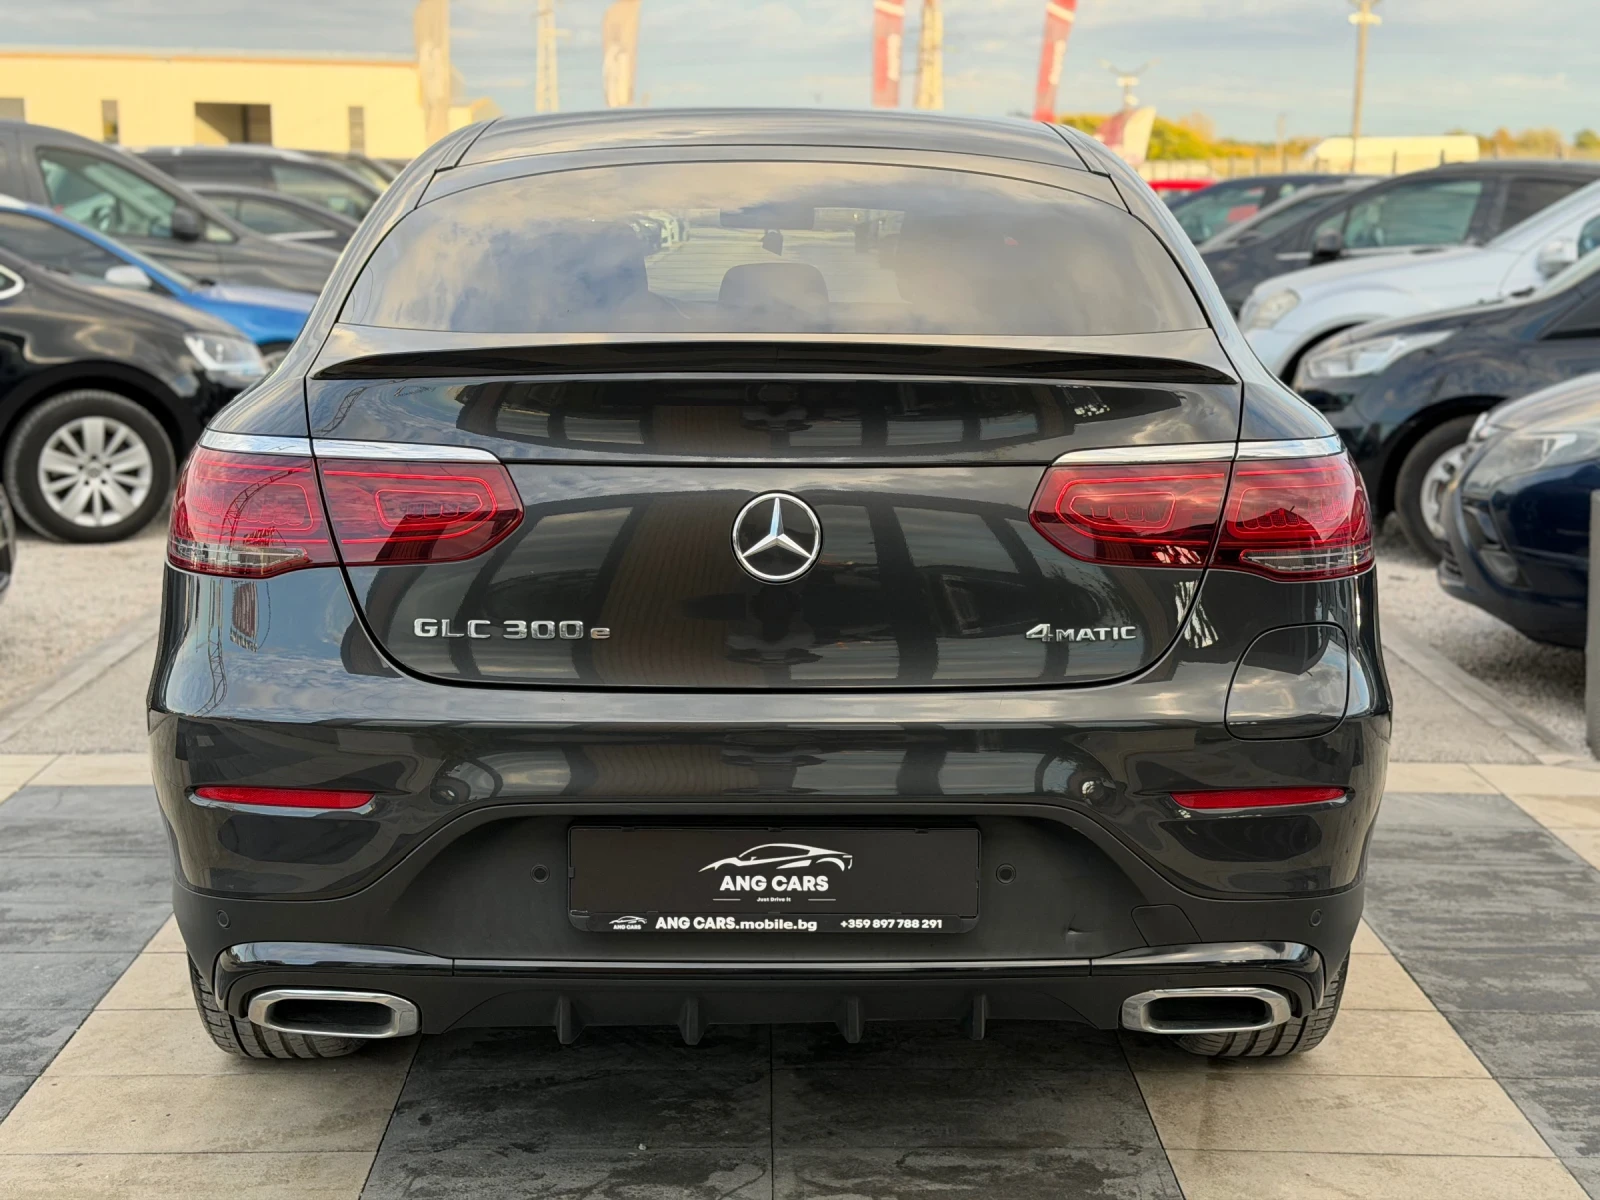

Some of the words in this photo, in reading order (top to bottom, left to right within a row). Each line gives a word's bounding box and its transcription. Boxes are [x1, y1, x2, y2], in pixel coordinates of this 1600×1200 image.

[413, 618, 491, 639] GLC
[503, 620, 584, 640] 300
[590, 627, 610, 639] e
[1025, 623, 1137, 642] 4MATIC
[719, 875, 767, 891] ANG
[771, 875, 829, 892] CARS
[655, 916, 691, 930] ANG
[693, 916, 818, 932] CARS.mobile.bg
[840, 919, 871, 929] +359
[872, 919, 895, 929] 897
[896, 919, 920, 929] 788
[921, 919, 943, 929] 291
